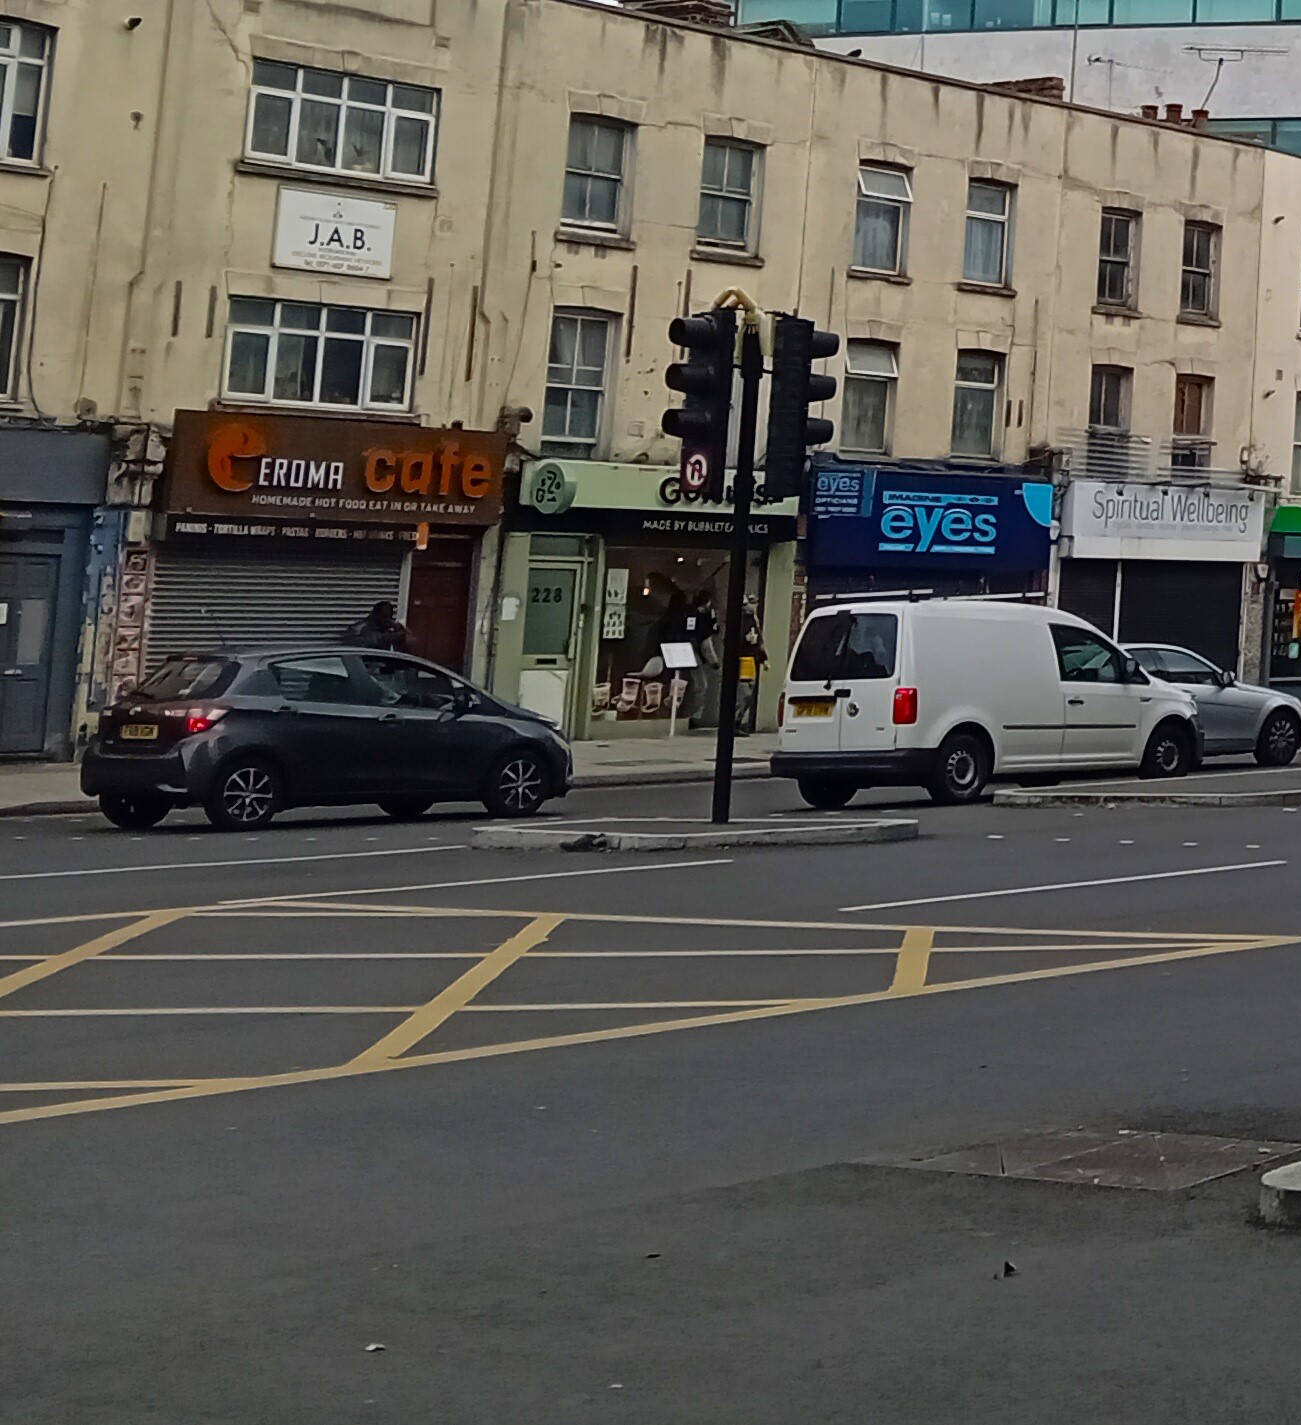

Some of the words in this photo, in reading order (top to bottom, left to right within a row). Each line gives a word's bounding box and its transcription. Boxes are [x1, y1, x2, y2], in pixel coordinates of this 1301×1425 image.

[308, 223, 371, 251] J.A.B.
[258, 458, 344, 490] EROMA
[364, 441, 491, 498] cafe
[817, 476, 860, 494] eyes
[251, 495, 312, 507] HOMEMADE
[315, 497, 337, 508] HOT
[339, 499, 366, 510] FOOD
[369, 500, 388, 511] EAT
[390, 501, 401, 511] IN
[404, 501, 417, 511] OR
[420, 502, 446, 513] TAKE
[447, 504, 475, 514] AWAY
[1092, 490, 1165, 528] Spiritual
[1171, 494, 1249, 533] Wellbeing
[643, 520, 672, 531] MADE
[674, 521, 686, 531] BY
[881, 506, 997, 552] eyes
[532, 587, 562, 603] 228
